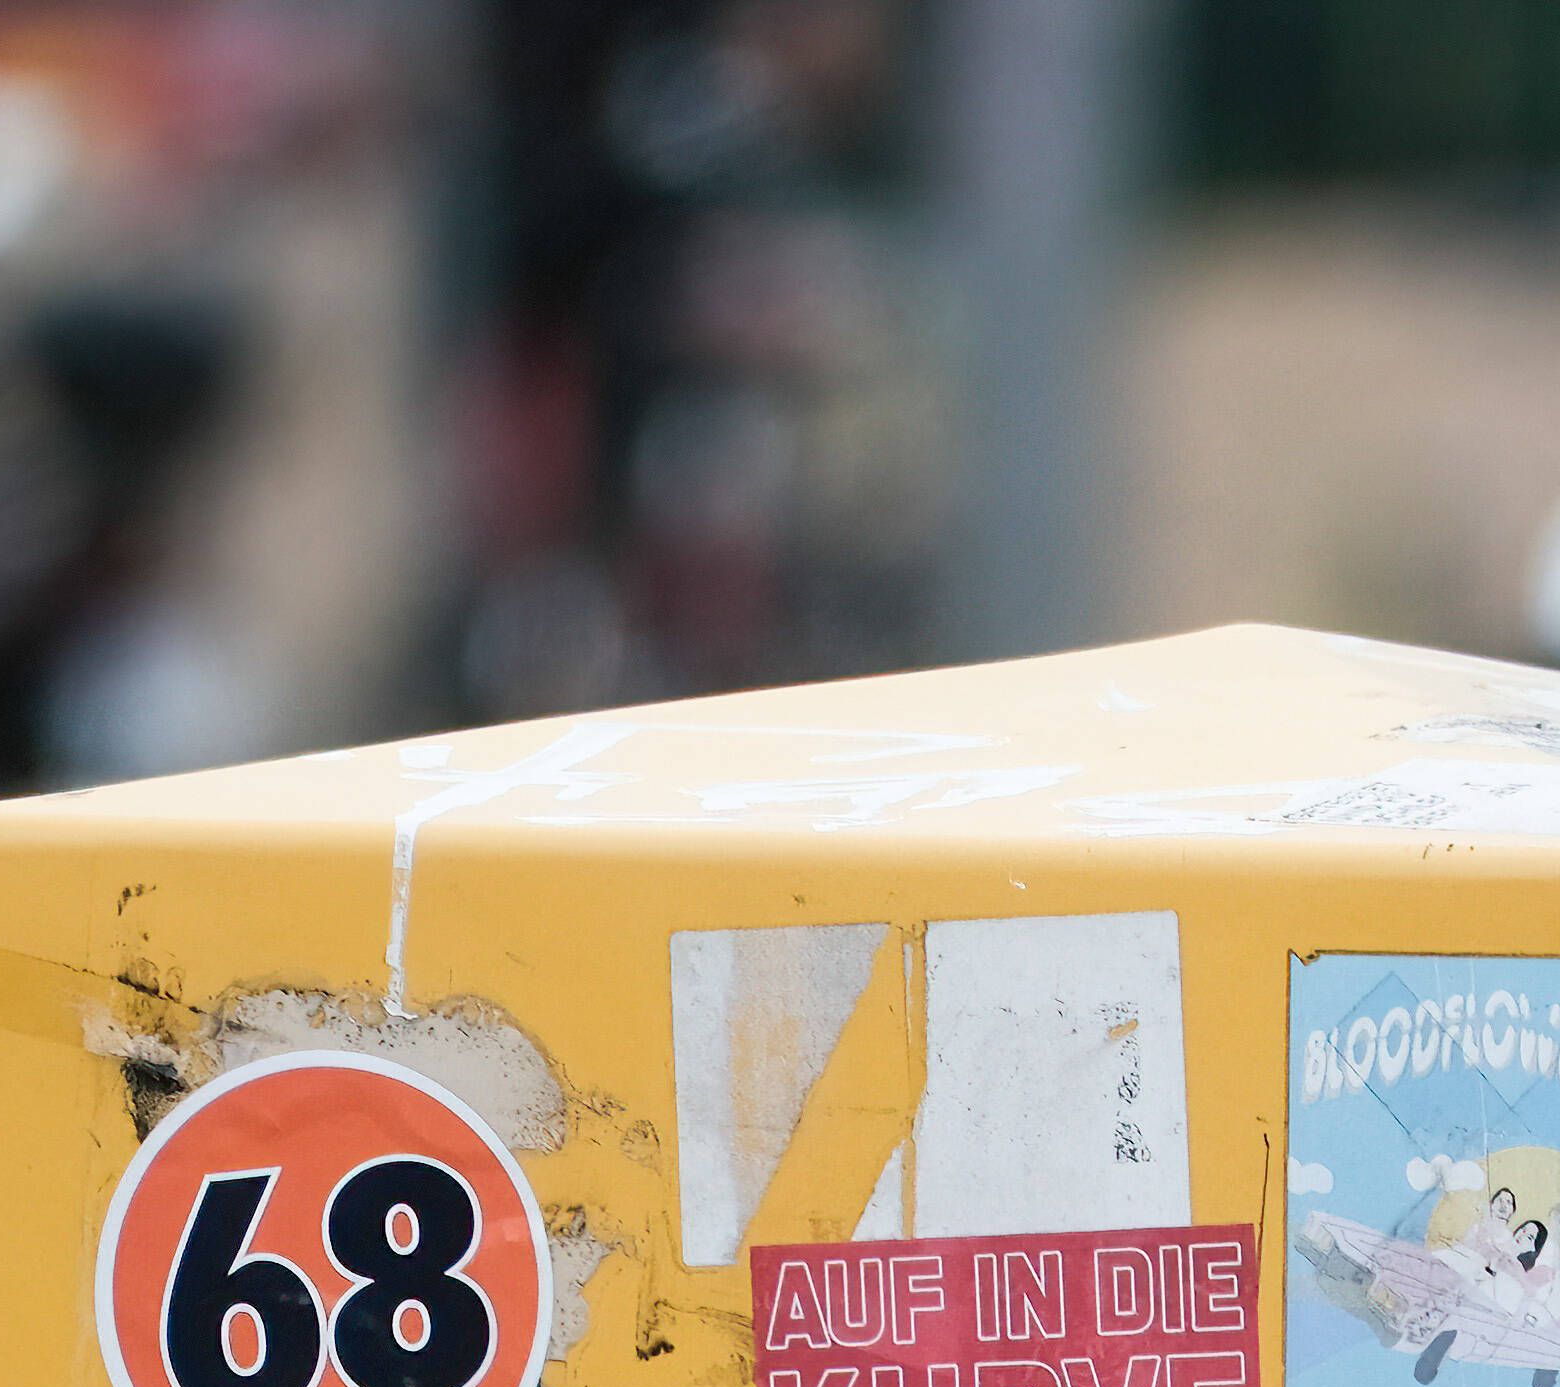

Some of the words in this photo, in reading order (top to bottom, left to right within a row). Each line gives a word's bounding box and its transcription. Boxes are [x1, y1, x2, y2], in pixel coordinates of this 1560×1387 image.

[766, 1255, 944, 1351] AUF
[974, 1251, 1066, 1341] IN
[1094, 1242, 1246, 1336] DIE
